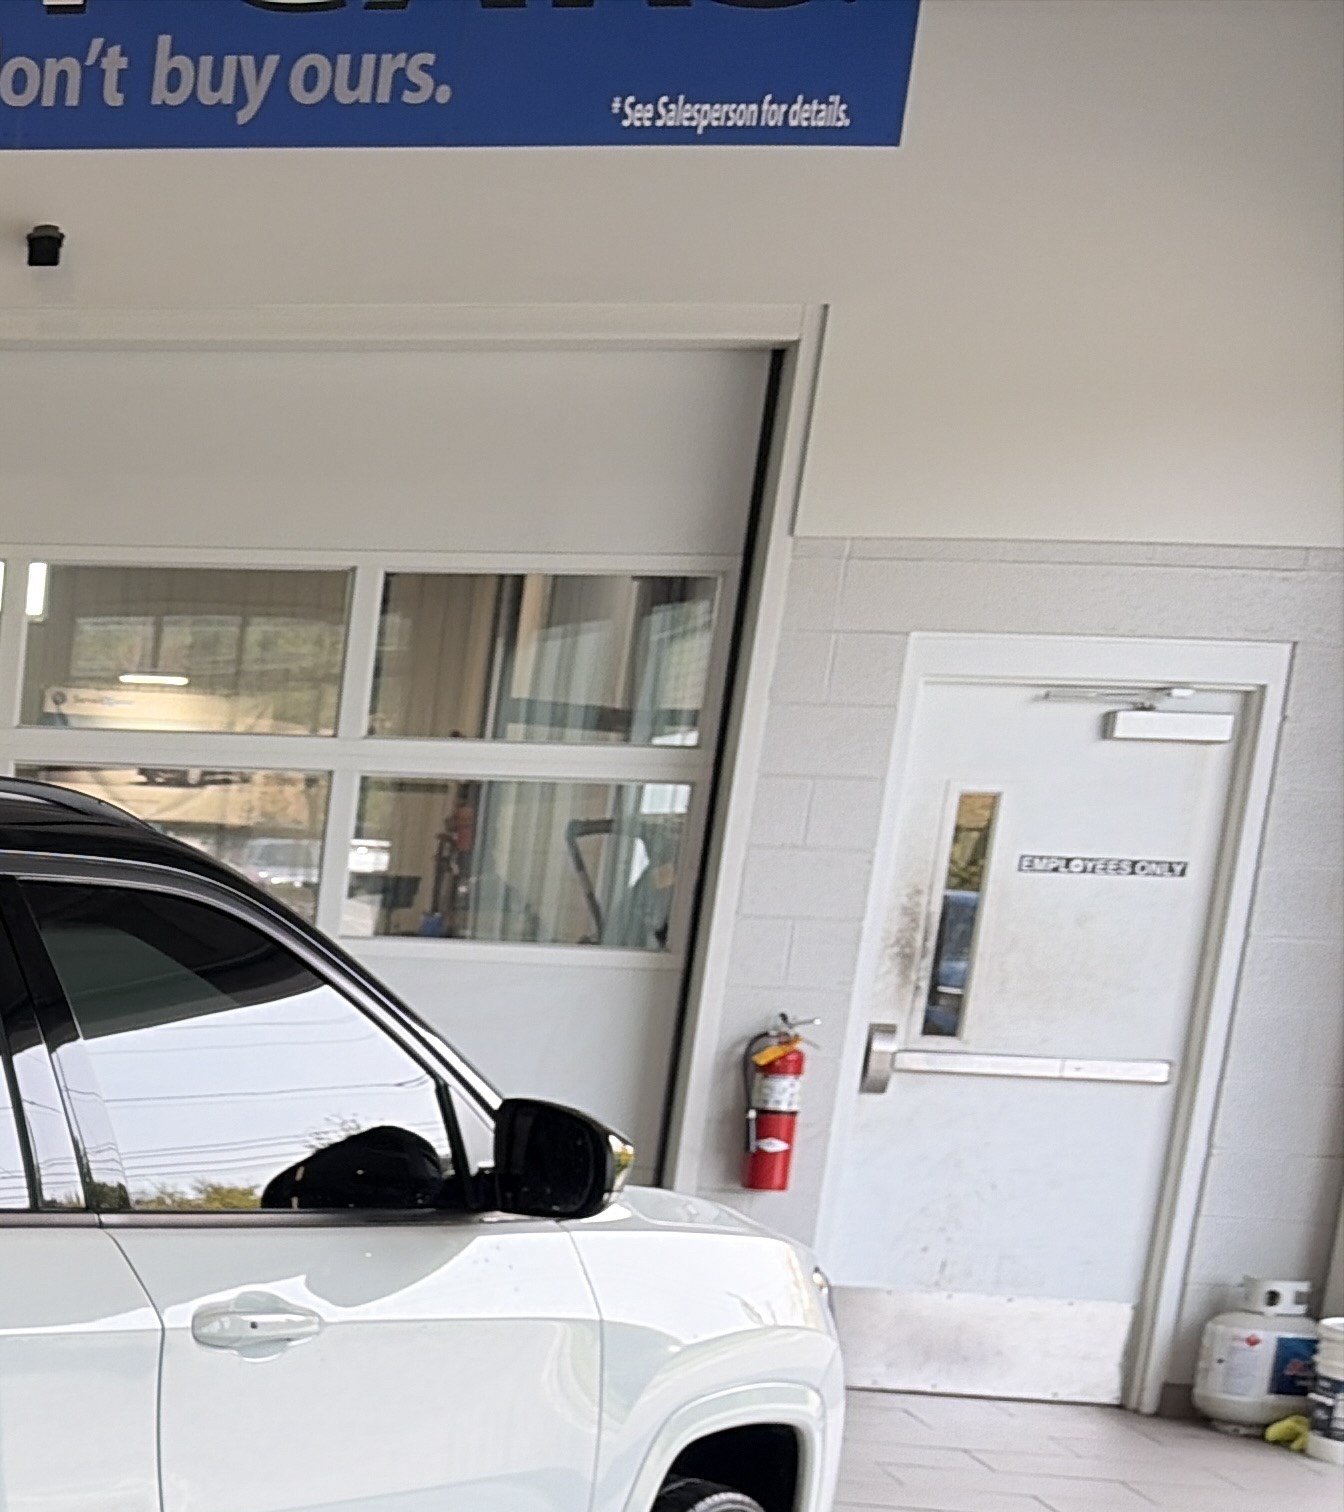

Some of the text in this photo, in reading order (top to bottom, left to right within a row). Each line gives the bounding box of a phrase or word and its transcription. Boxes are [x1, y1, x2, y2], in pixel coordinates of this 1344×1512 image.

[150, 34, 280, 125] buy
[289, 52, 451, 105] ours.
[654, 94, 759, 135] Salesperson
[760, 93, 789, 127] for
[789, 94, 851, 128] details.
[1021, 855, 1186, 877] EMPLOYEES ONLY
